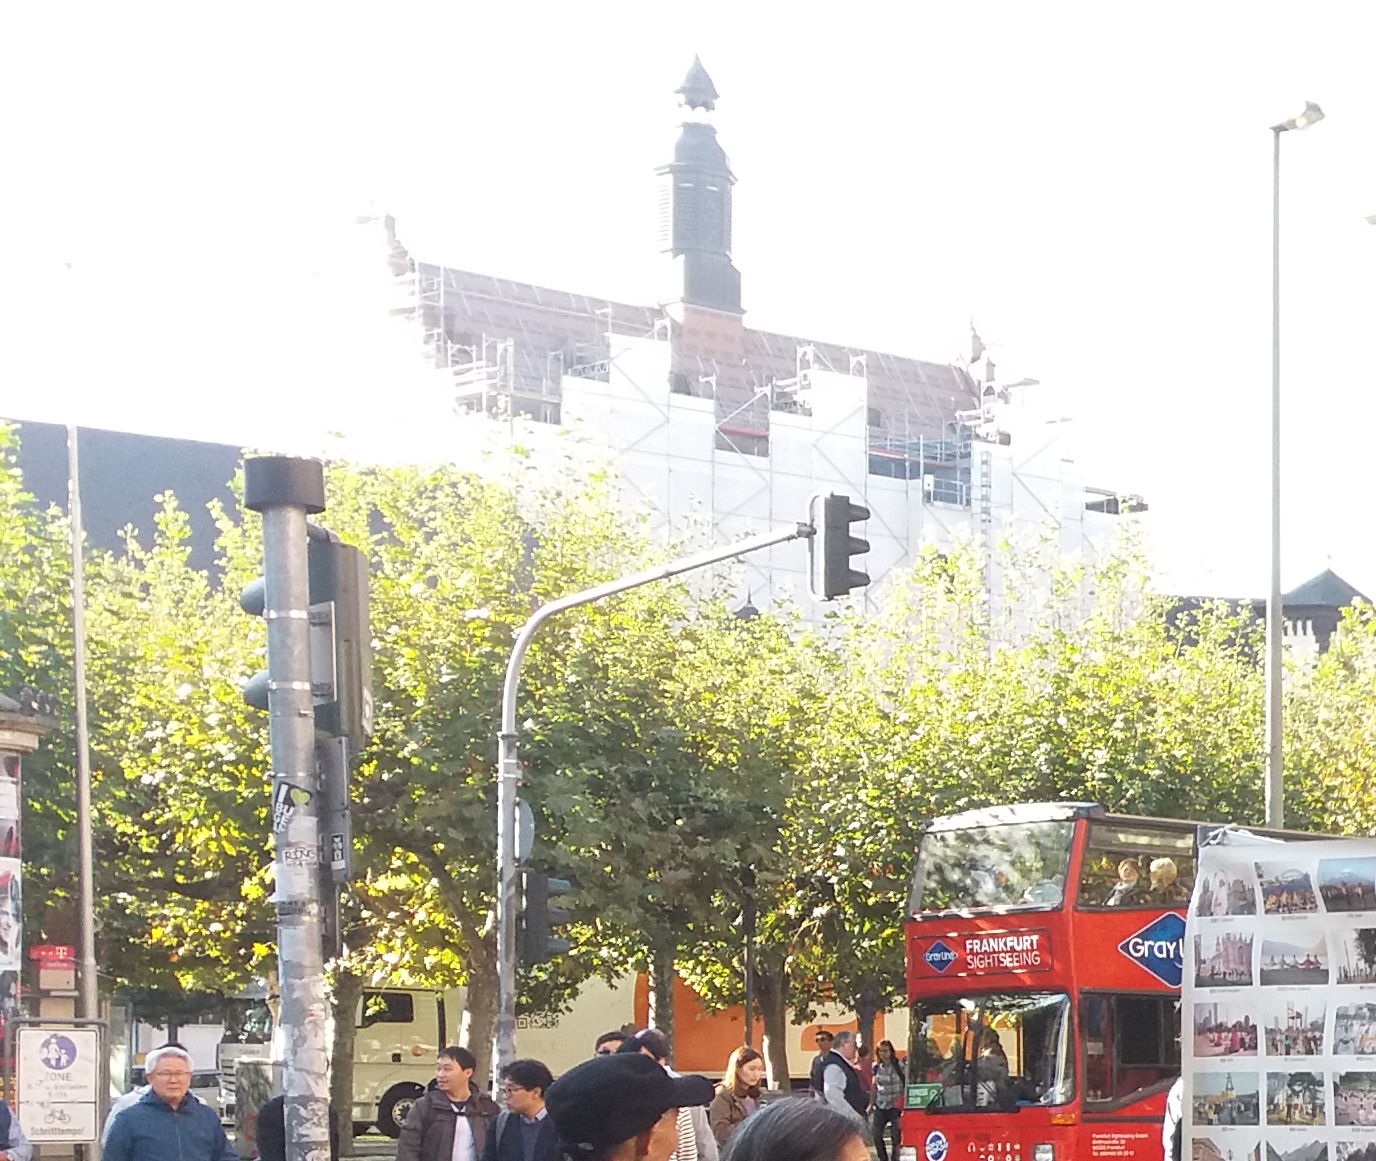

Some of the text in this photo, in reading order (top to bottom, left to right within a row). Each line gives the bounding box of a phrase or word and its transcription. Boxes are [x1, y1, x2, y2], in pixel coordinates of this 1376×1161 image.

[965, 935, 1039, 953] FRANKFURT
[967, 951, 1041, 969] SIGHTSEEING
[45, 1073, 72, 1081] ZONE
